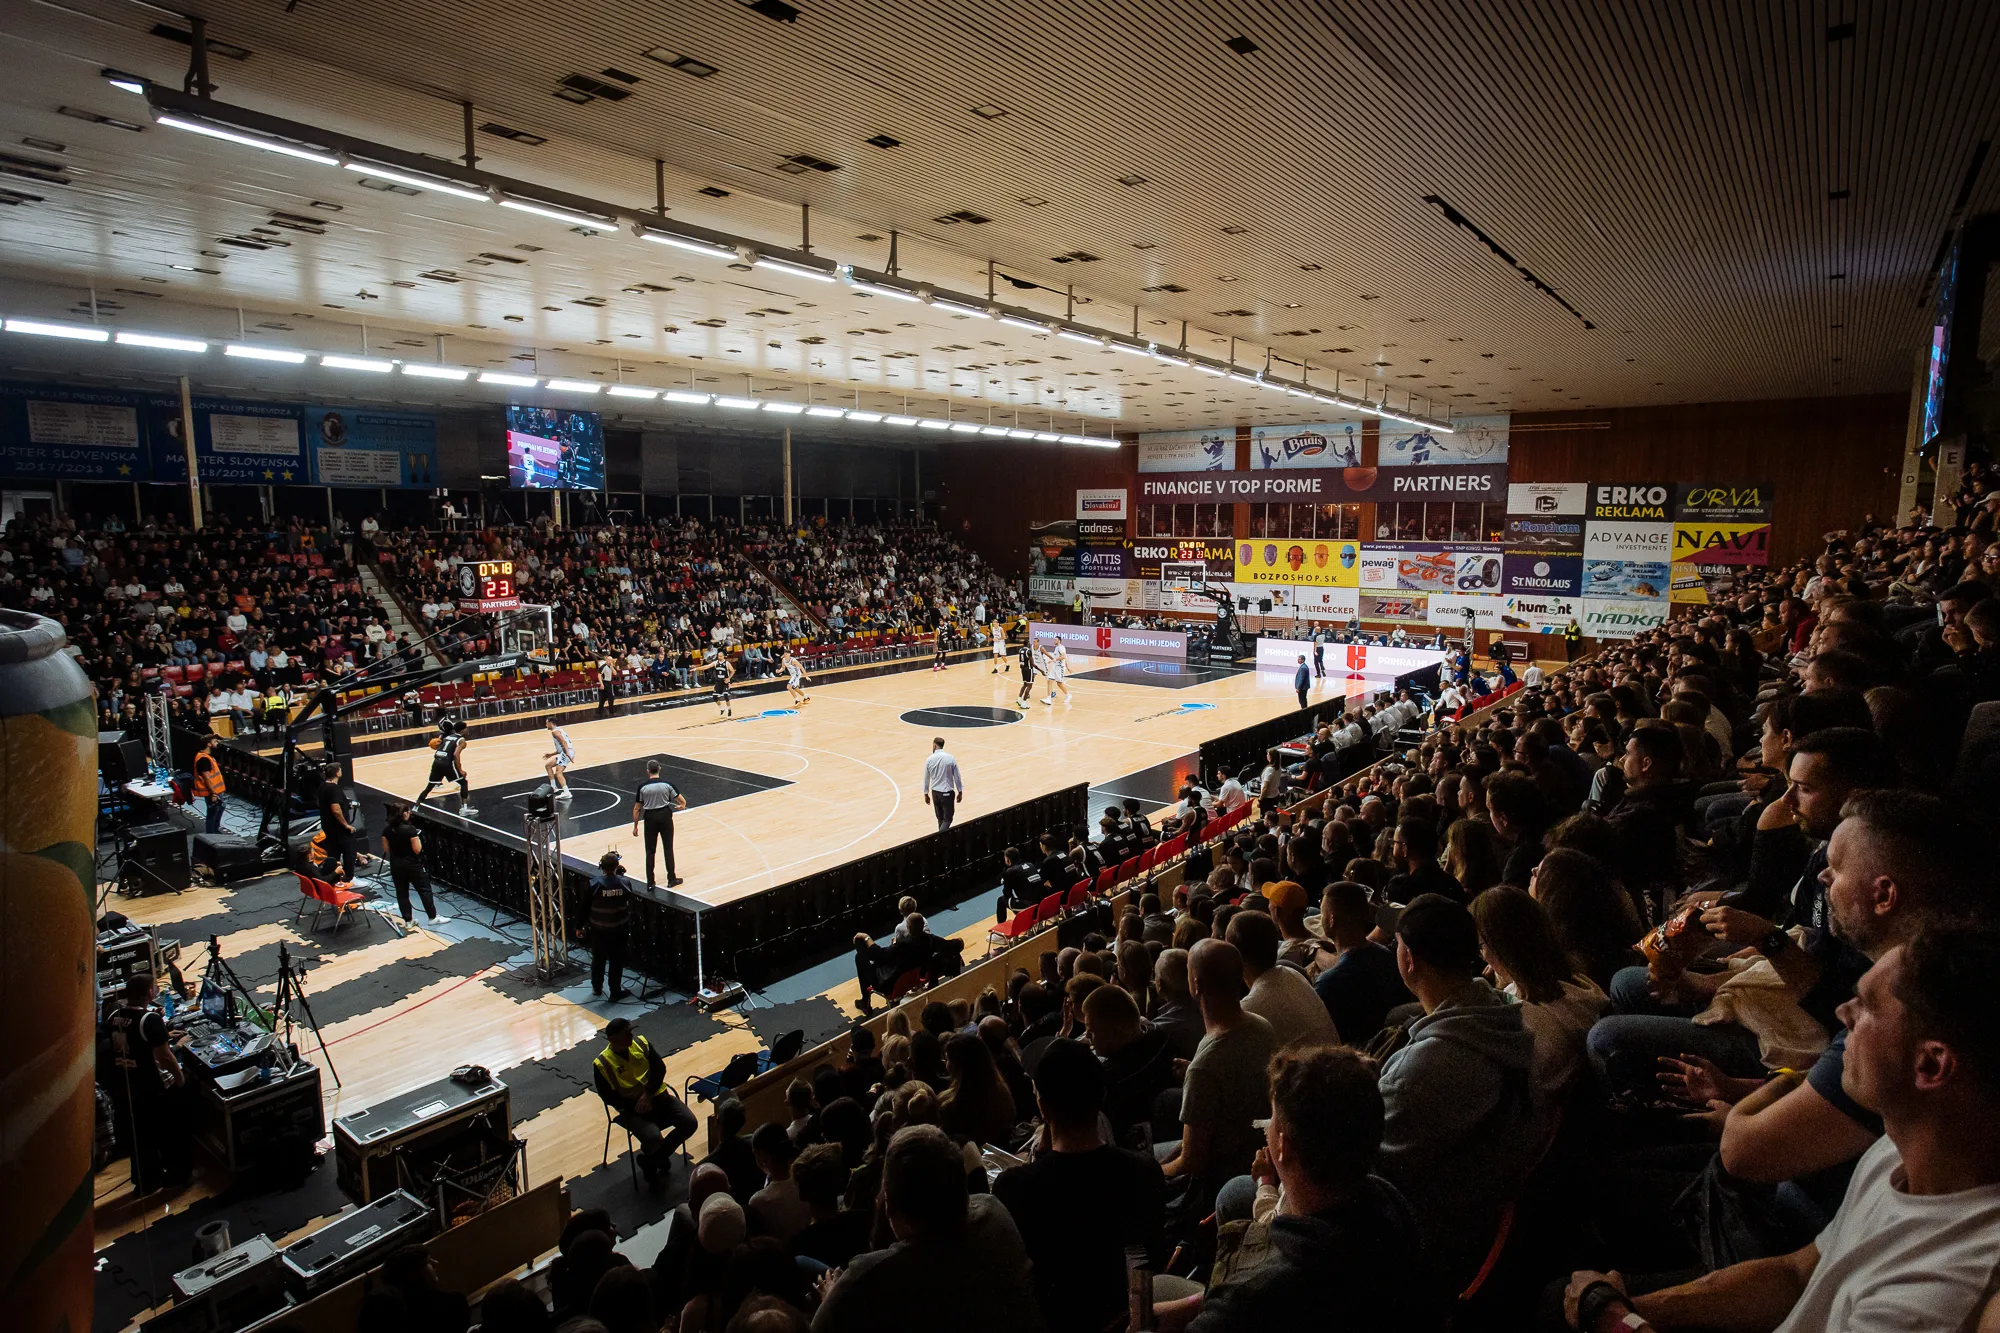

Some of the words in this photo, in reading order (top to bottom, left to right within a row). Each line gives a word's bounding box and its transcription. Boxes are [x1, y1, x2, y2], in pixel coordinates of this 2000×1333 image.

[53, 449, 138, 461] SLOVENSKA
[1947, 452, 1957, 464] E
[15, 462, 104, 473] 2017/2018
[230, 456, 299, 468] SLOVENSKA
[182, 468, 254, 478] 218/2019
[192, 477, 198, 487] A
[1393, 475, 1491, 492] PARTNERS
[1906, 475, 1914, 483] D
[1144, 480, 1212, 495] FINANCIE
[1215, 480, 1227, 494] V
[1230, 479, 1260, 494] TOP
[1264, 478, 1322, 493] FORME
[1597, 486, 1668, 505] ERKO
[1686, 487, 1761, 507] ORVA
[1595, 506, 1665, 518] REKLAMA
[1522, 521, 1580, 533] Ronchem
[1675, 530, 1767, 551] NAVI
[1134, 547, 1168, 558] ERKO
[1181, 550, 1192, 559] 23
[1092, 554, 1121, 565] ATTIS
[1362, 558, 1394, 568] pewag
[1253, 573, 1337, 583] BOZPOSHOP.SK
[482, 600, 517, 609] PARTNERS
[1120, 637, 1148, 646] PRIHRAJ
[1157, 640, 1181, 648] JEDNO
[1265, 648, 1297, 657] PRIHRAJ
[1378, 656, 1415, 667] PRIHRAJ
[602, 889, 624, 897] PHOTO
[460, 1163, 504, 1187] Wilson
